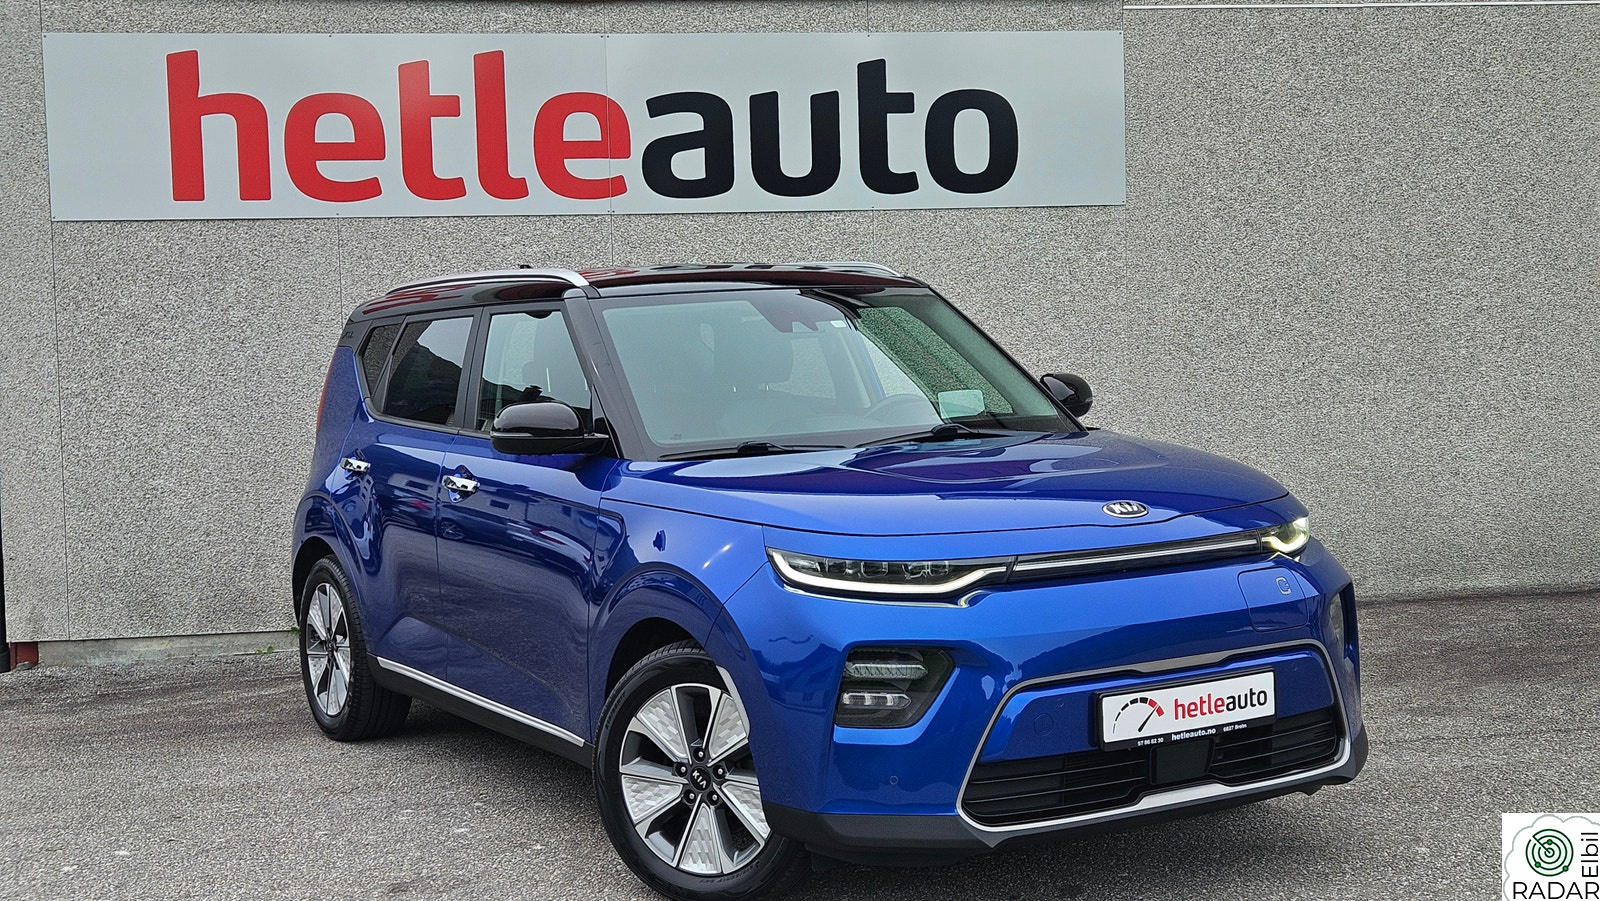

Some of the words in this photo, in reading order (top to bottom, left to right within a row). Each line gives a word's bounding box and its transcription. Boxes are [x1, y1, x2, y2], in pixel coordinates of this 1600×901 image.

[166, 50, 1019, 202] hetleauto
[1109, 502, 1145, 514] KIA
[1174, 688, 1267, 720] hetleauto
[1171, 728, 1216, 740] hetleauto.no
[692, 770, 706, 789] KIA
